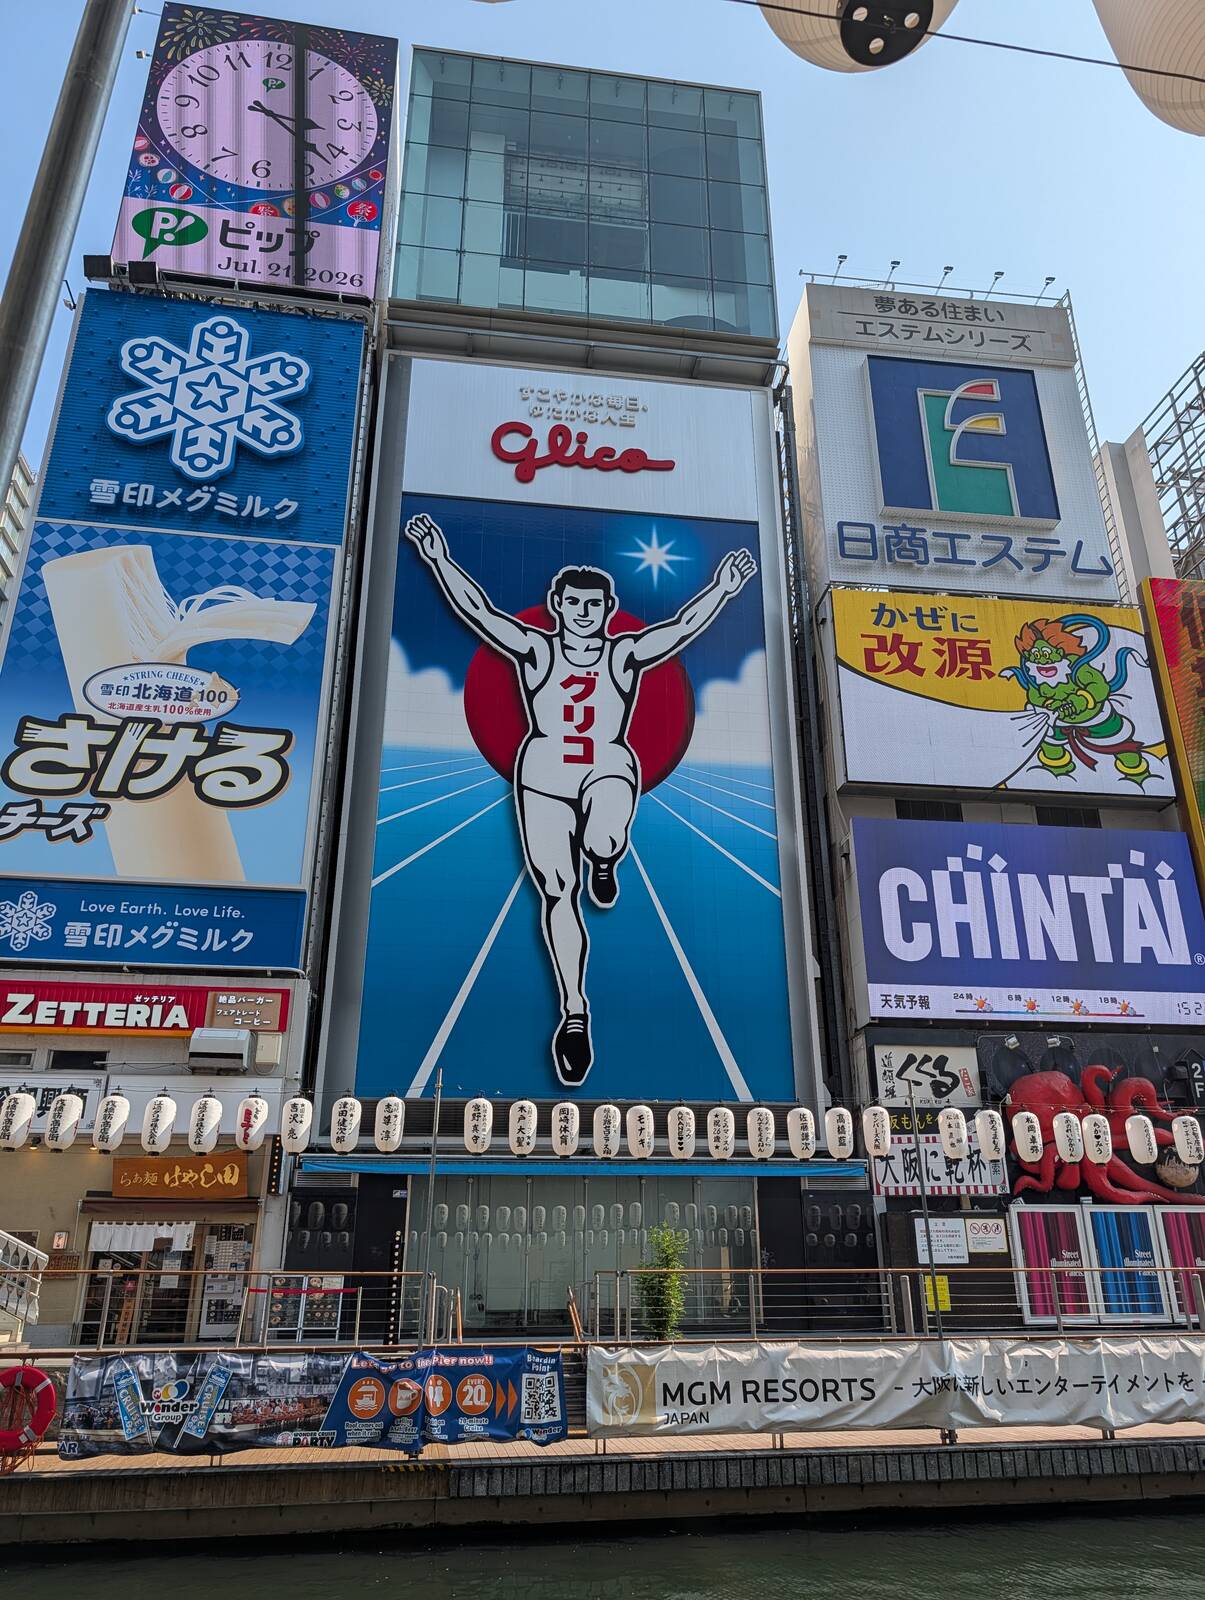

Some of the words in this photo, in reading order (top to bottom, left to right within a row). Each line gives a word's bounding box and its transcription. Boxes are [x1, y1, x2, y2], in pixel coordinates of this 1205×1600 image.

[224, 51, 251, 71] 11
[262, 51, 293, 71] 12
[187, 64, 220, 90] 10
[174, 94, 200, 109] 9
[328, 89, 354, 106] 2
[181, 123, 208, 139] 8
[337, 118, 362, 132] 3
[211, 146, 239, 163] 7
[326, 142, 350, 160] 4
[251, 159, 272, 179] 6
[218, 219, 321, 256] ピップ
[217, 256, 262, 275] Jul.
[304, 267, 364, 288] 2026
[873, 295, 1005, 323] 夢ある住まい
[855, 320, 1032, 352] エステムシリーズ
[89, 478, 299, 520] 雪印メグミルク
[837, 520, 1115, 576] 日商エステム
[870, 602, 979, 634] かぜに
[860, 632, 997, 681] 改源
[129, 670, 163, 682] STRING
[166, 670, 200, 687] CHEESE
[108, 701, 212, 717] 北海道産生乳100%使用
[559, 671, 600, 765] グリコ
[6, 716, 289, 804] さける
[0, 803, 107, 838] チーズ
[80, 900, 115, 914] Love
[120, 902, 167, 916] Earth.
[174, 903, 209, 918] Love
[213, 905, 246, 919] Life.
[878, 843, 1192, 966] CHINTAI
[63, 920, 254, 953] 雪印メグミルク
[134, 994, 176, 1004] ゼッテリア
[218, 994, 274, 1006] 絶品バーガー
[880, 993, 931, 1011] 天気予報
[953, 992, 974, 1001] 24時
[1007, 994, 1023, 1002] 6時
[1051, 995, 1071, 1004] 12時
[1, 993, 190, 1028] ZETTERIA
[234, 1017, 272, 1026] コーヒー
[895, 1053, 961, 1099] くくる
[287, 1102, 299, 1140] 吉沢亮
[335, 1101, 348, 1144] 津田健次郎
[380, 1102, 394, 1142] 志尊淳
[471, 1103, 482, 1144] 宮野真守
[516, 1104, 528, 1148] 木戸大聖
[558, 1107, 570, 1147] 岡崎体育
[120, 1171, 159, 1187] らあ麺
[164, 1162, 240, 1189] はやし田
[880, 1146, 987, 1185] 大阪に乾杯
[1061, 1250, 1080, 1258] Street
[1134, 1249, 1152, 1258] Street
[662, 1380, 731, 1407] MGM
[743, 1377, 876, 1404] RESORTS
[154, 1413, 182, 1423] Group
[664, 1411, 710, 1425] JAPAN
